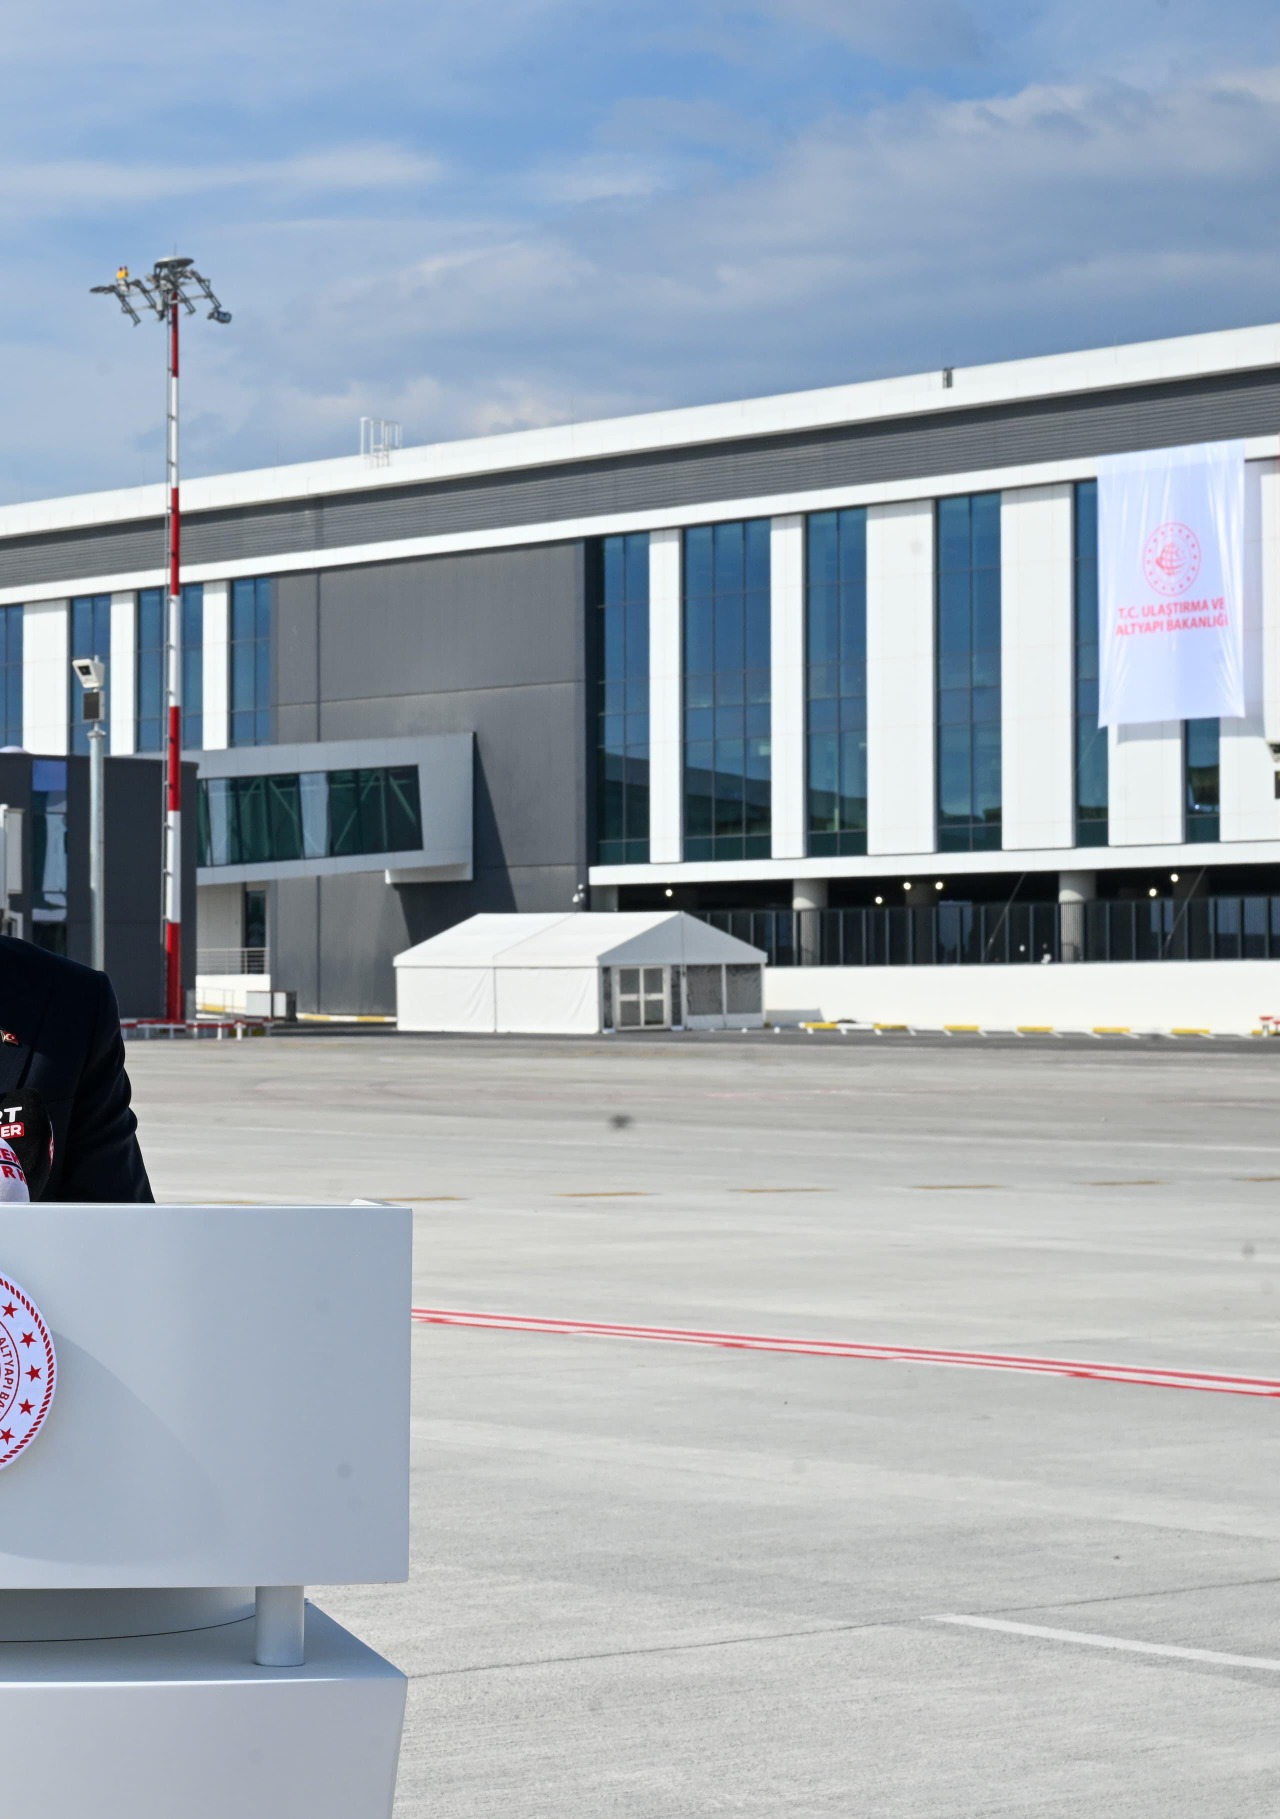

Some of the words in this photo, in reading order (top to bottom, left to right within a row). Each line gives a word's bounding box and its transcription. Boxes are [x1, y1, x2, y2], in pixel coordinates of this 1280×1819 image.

[1118, 607, 1139, 619] T.C.
[1142, 599, 1209, 617] ULAŞTIRMA
[1211, 597, 1225, 610] VE
[1116, 620, 1164, 636] ALTYAPI
[1166, 613, 1229, 632] BAKANLIĞI
